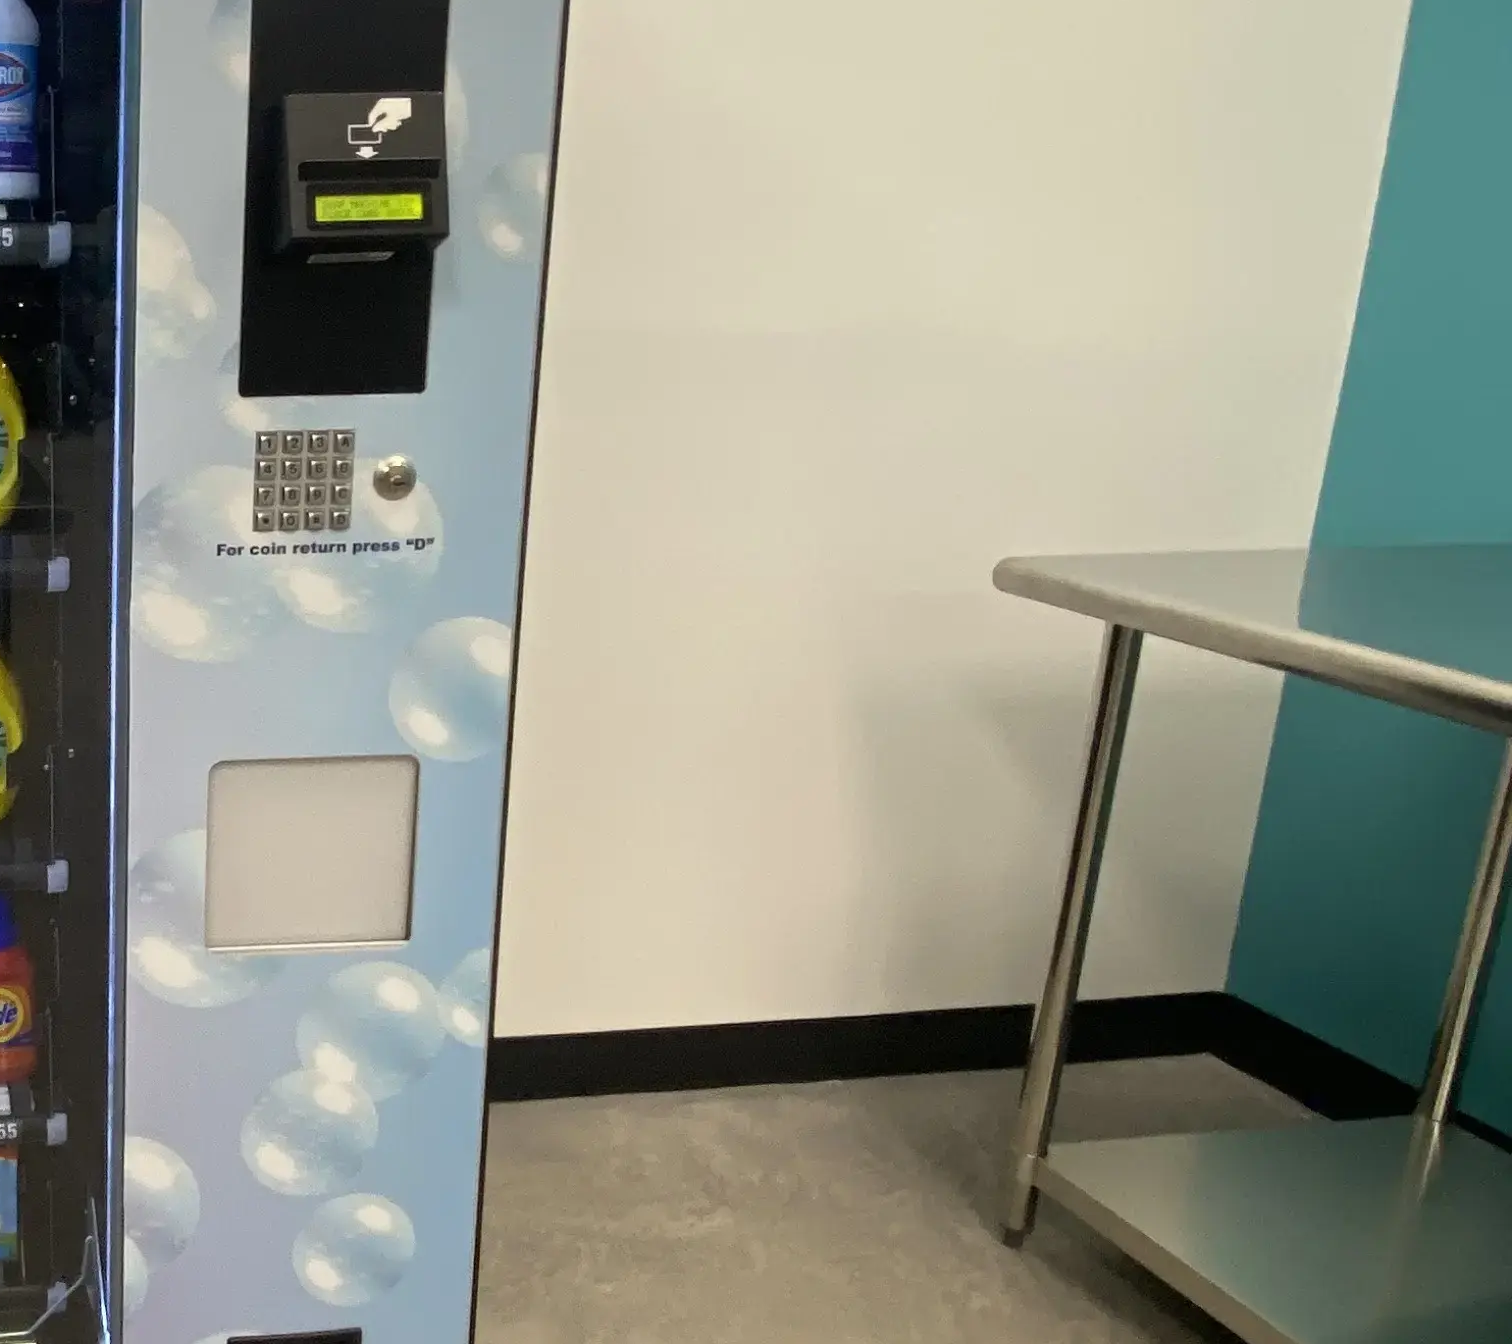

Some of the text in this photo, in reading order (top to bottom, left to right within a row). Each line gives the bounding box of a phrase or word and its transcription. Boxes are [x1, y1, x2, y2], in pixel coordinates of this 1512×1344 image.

[216, 543, 244, 557] For
[250, 541, 287, 556] coin
[292, 540, 347, 555] return
[352, 539, 400, 556] press
